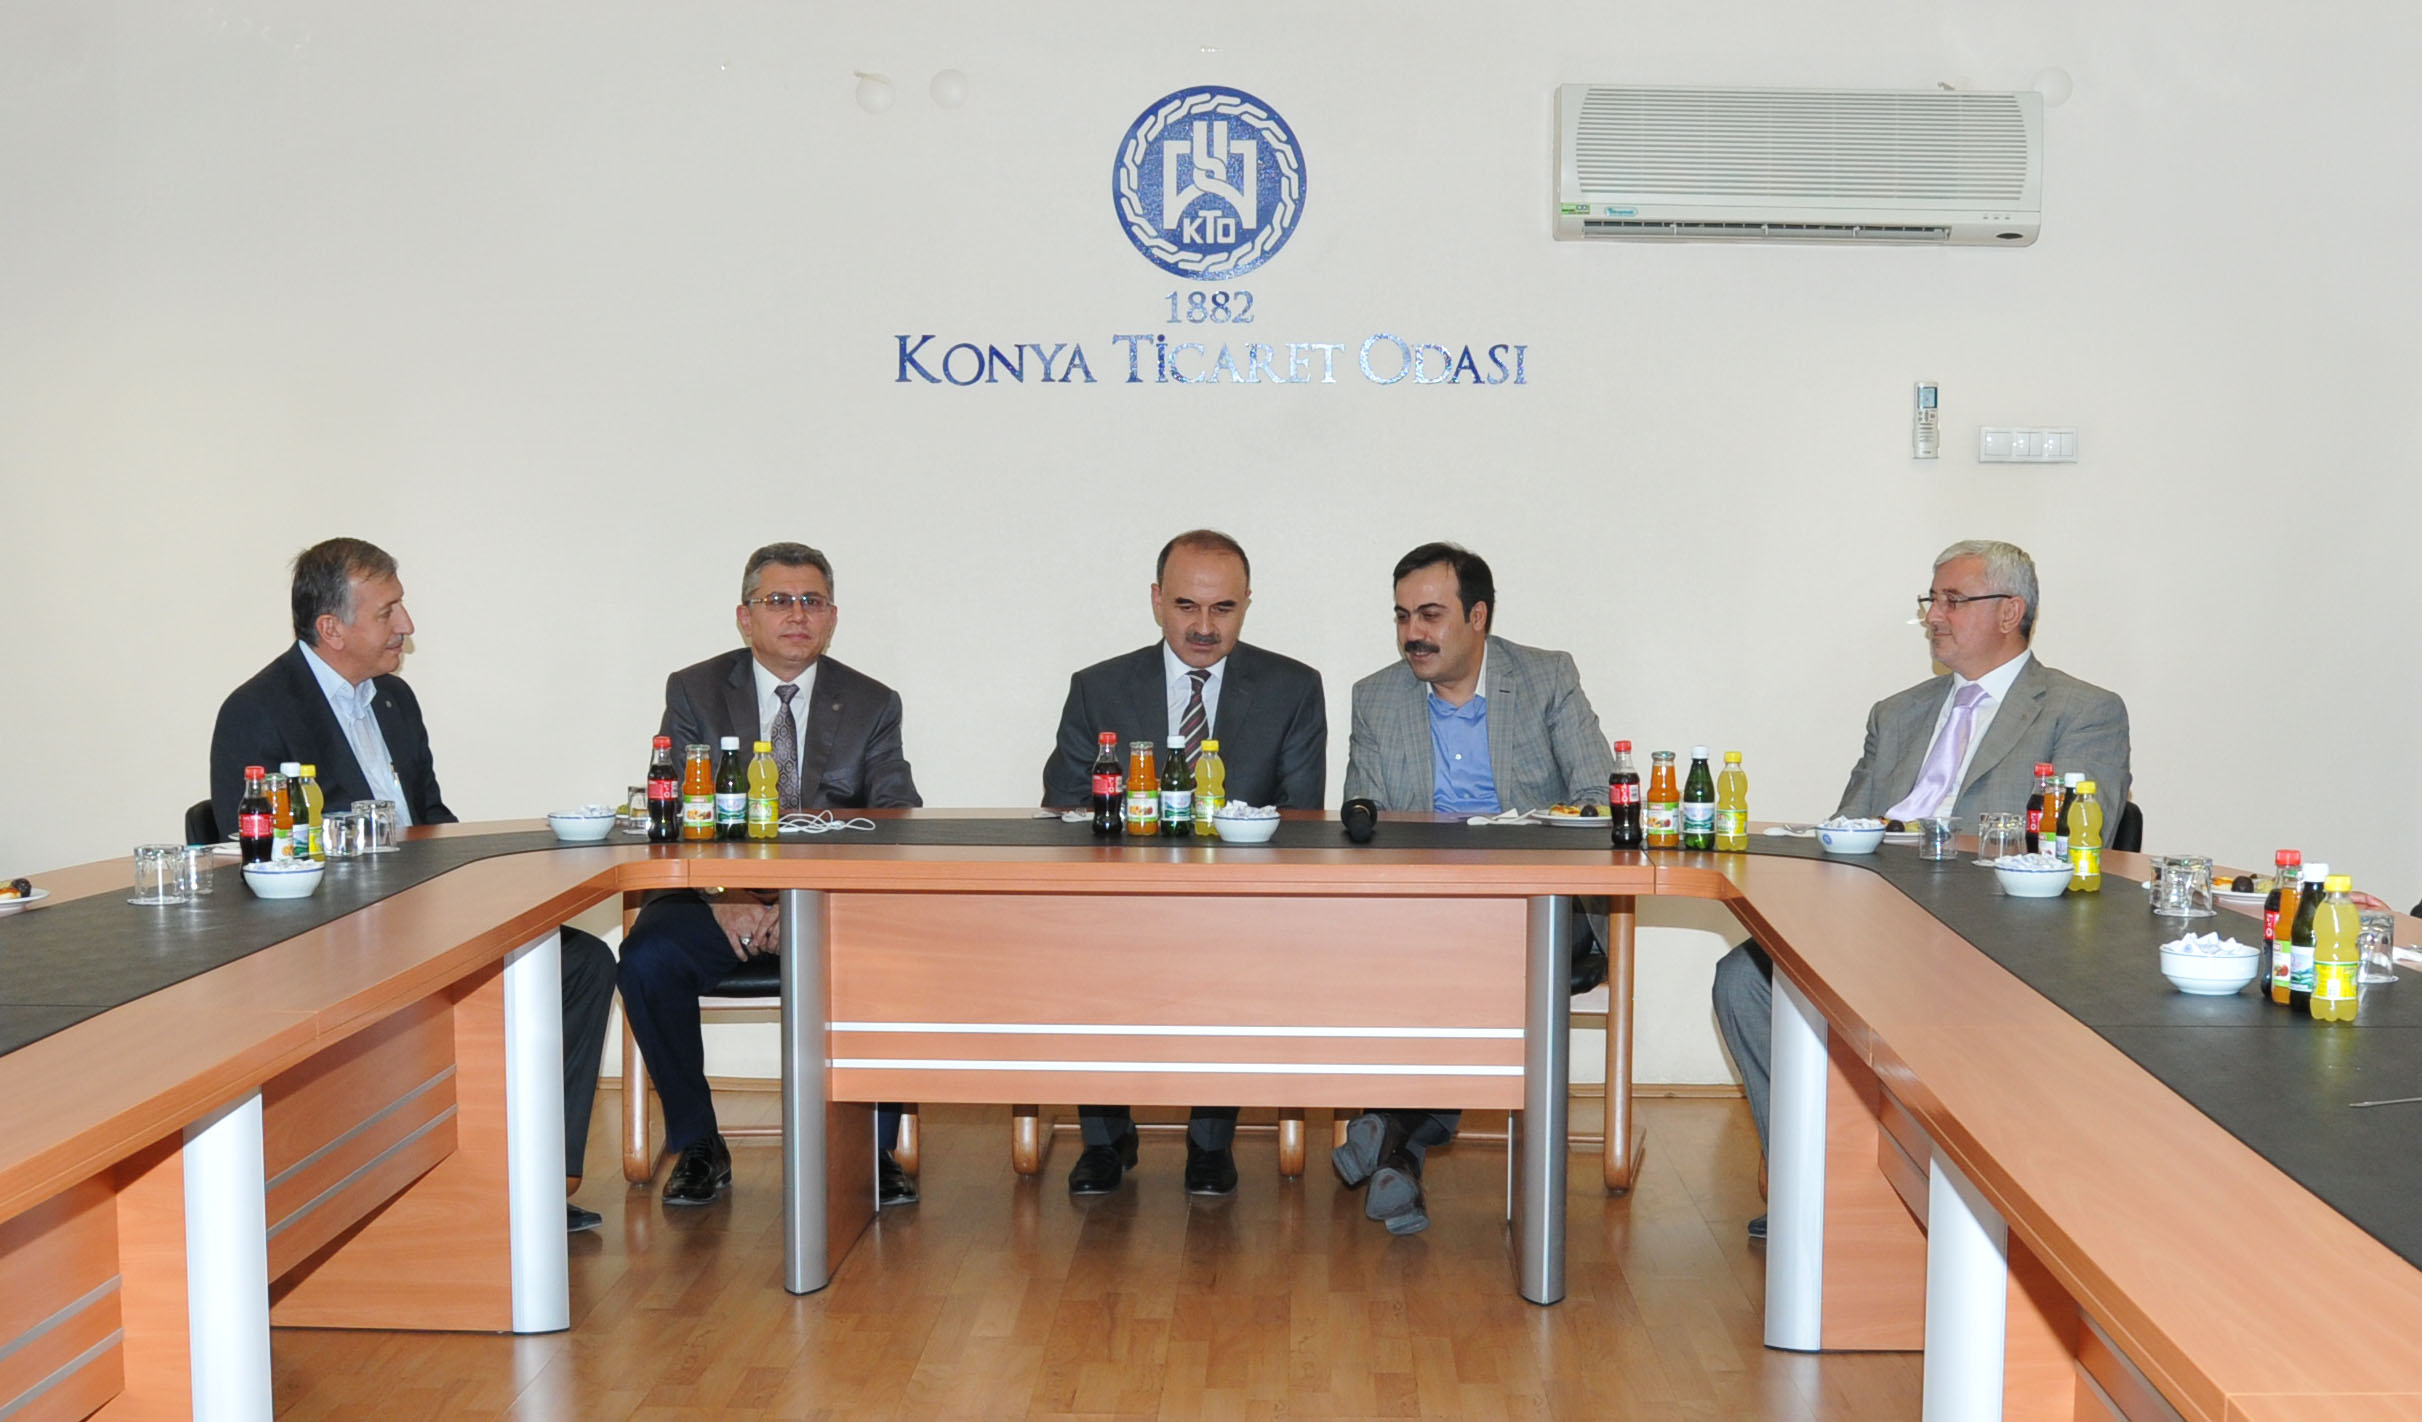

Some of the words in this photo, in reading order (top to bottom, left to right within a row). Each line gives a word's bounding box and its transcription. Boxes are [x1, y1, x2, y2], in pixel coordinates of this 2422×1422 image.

[1182, 209, 1236, 244] KTO
[1165, 290, 1255, 324] 1882
[894, 334, 1098, 387] KONYA
[1358, 332, 1528, 386] ODASI
